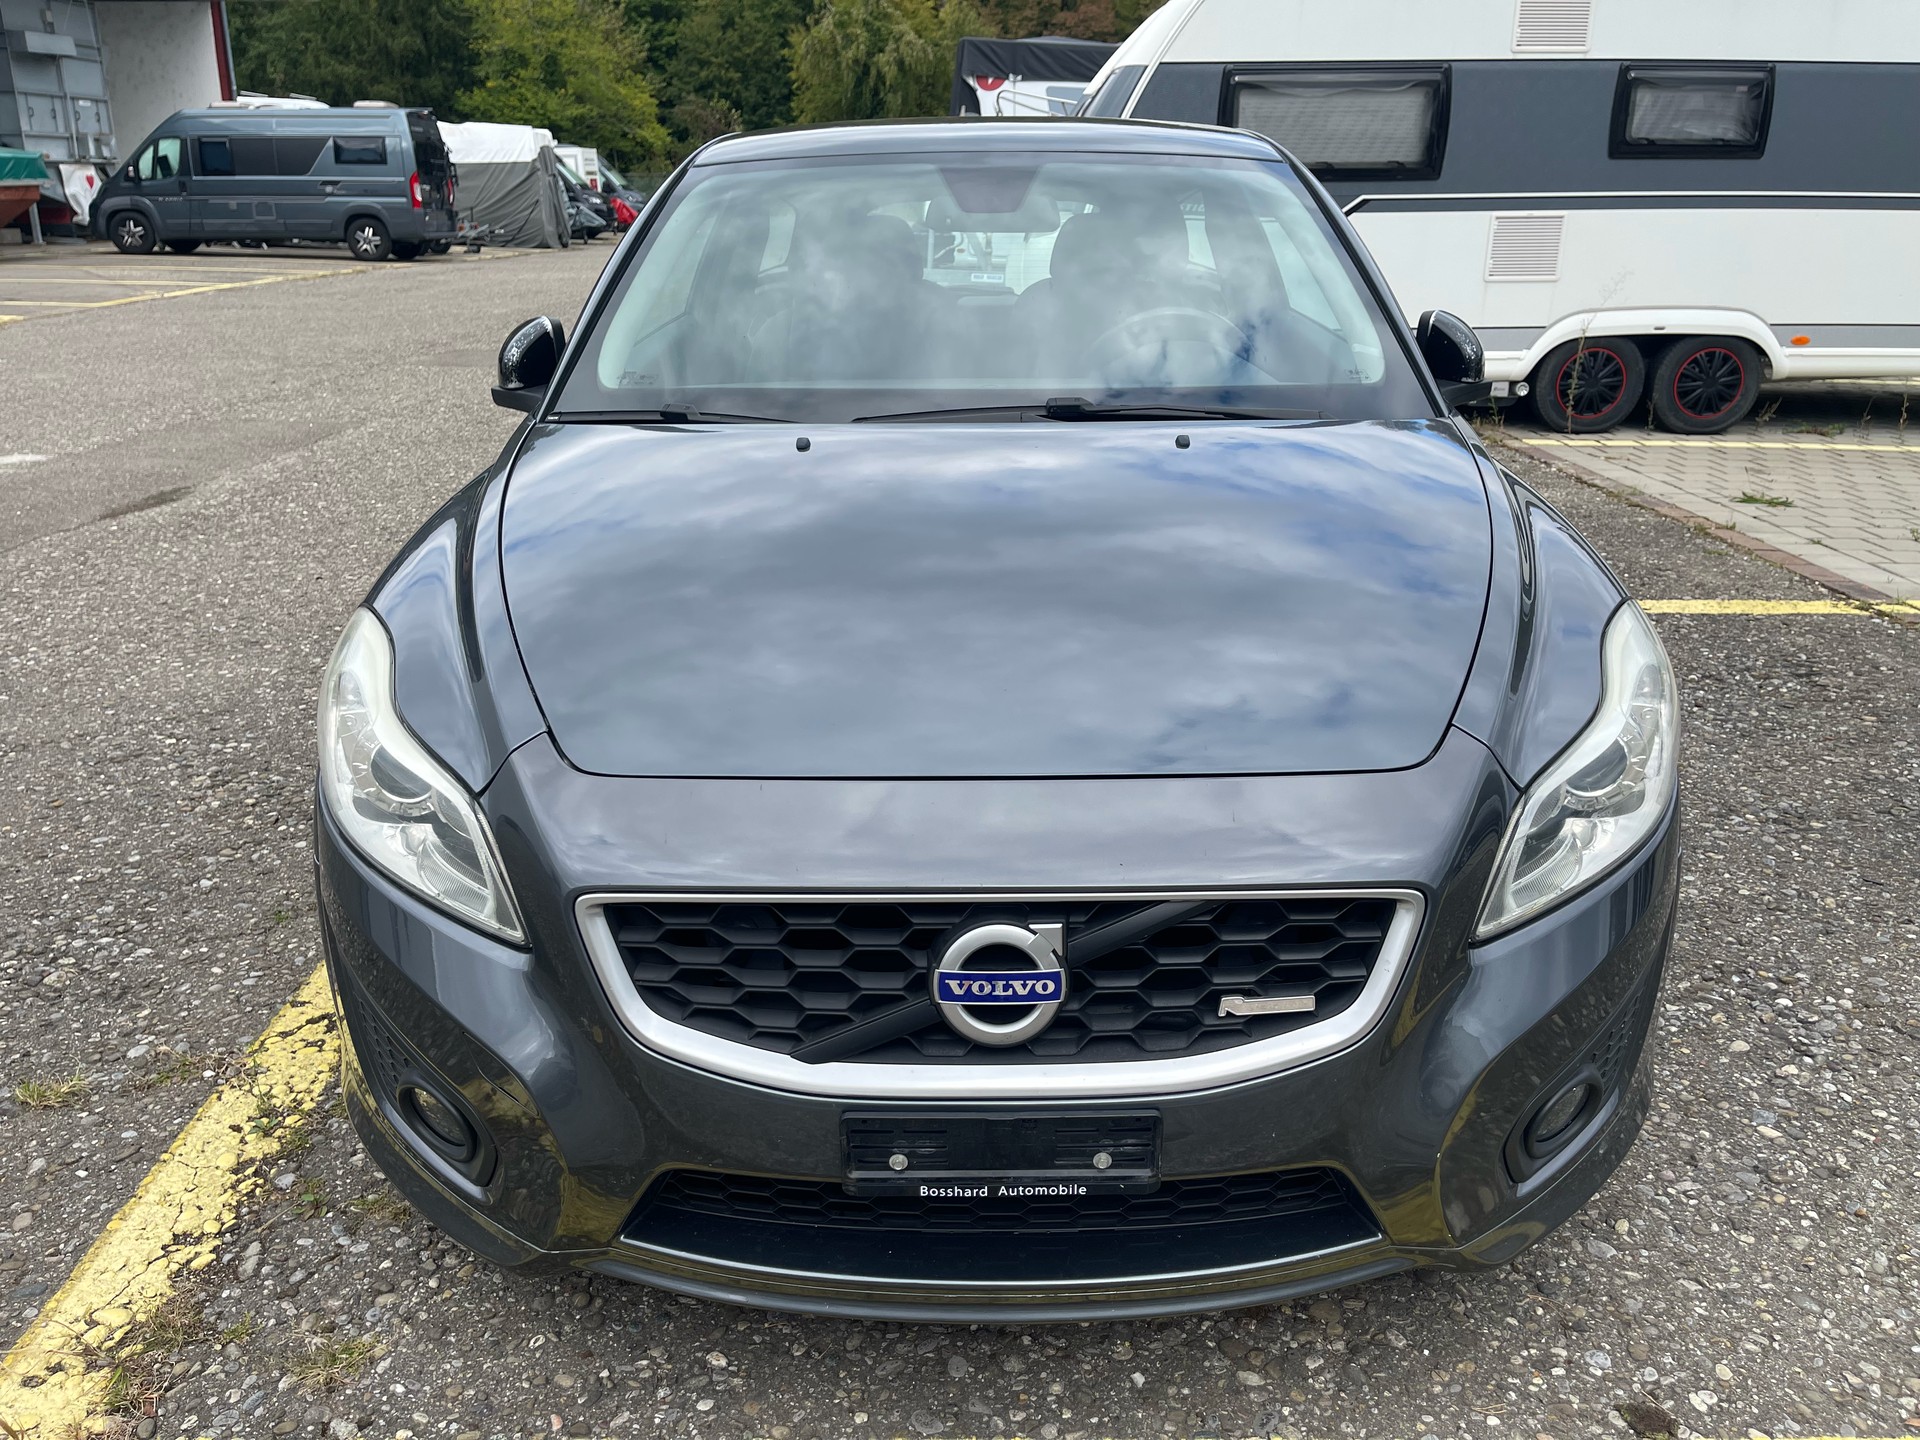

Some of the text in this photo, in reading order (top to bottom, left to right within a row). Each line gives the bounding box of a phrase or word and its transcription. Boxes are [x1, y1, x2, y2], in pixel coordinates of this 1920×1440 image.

[945, 979, 1056, 996] VOLVO
[919, 1184, 1088, 1197] Bosshard Automobile
